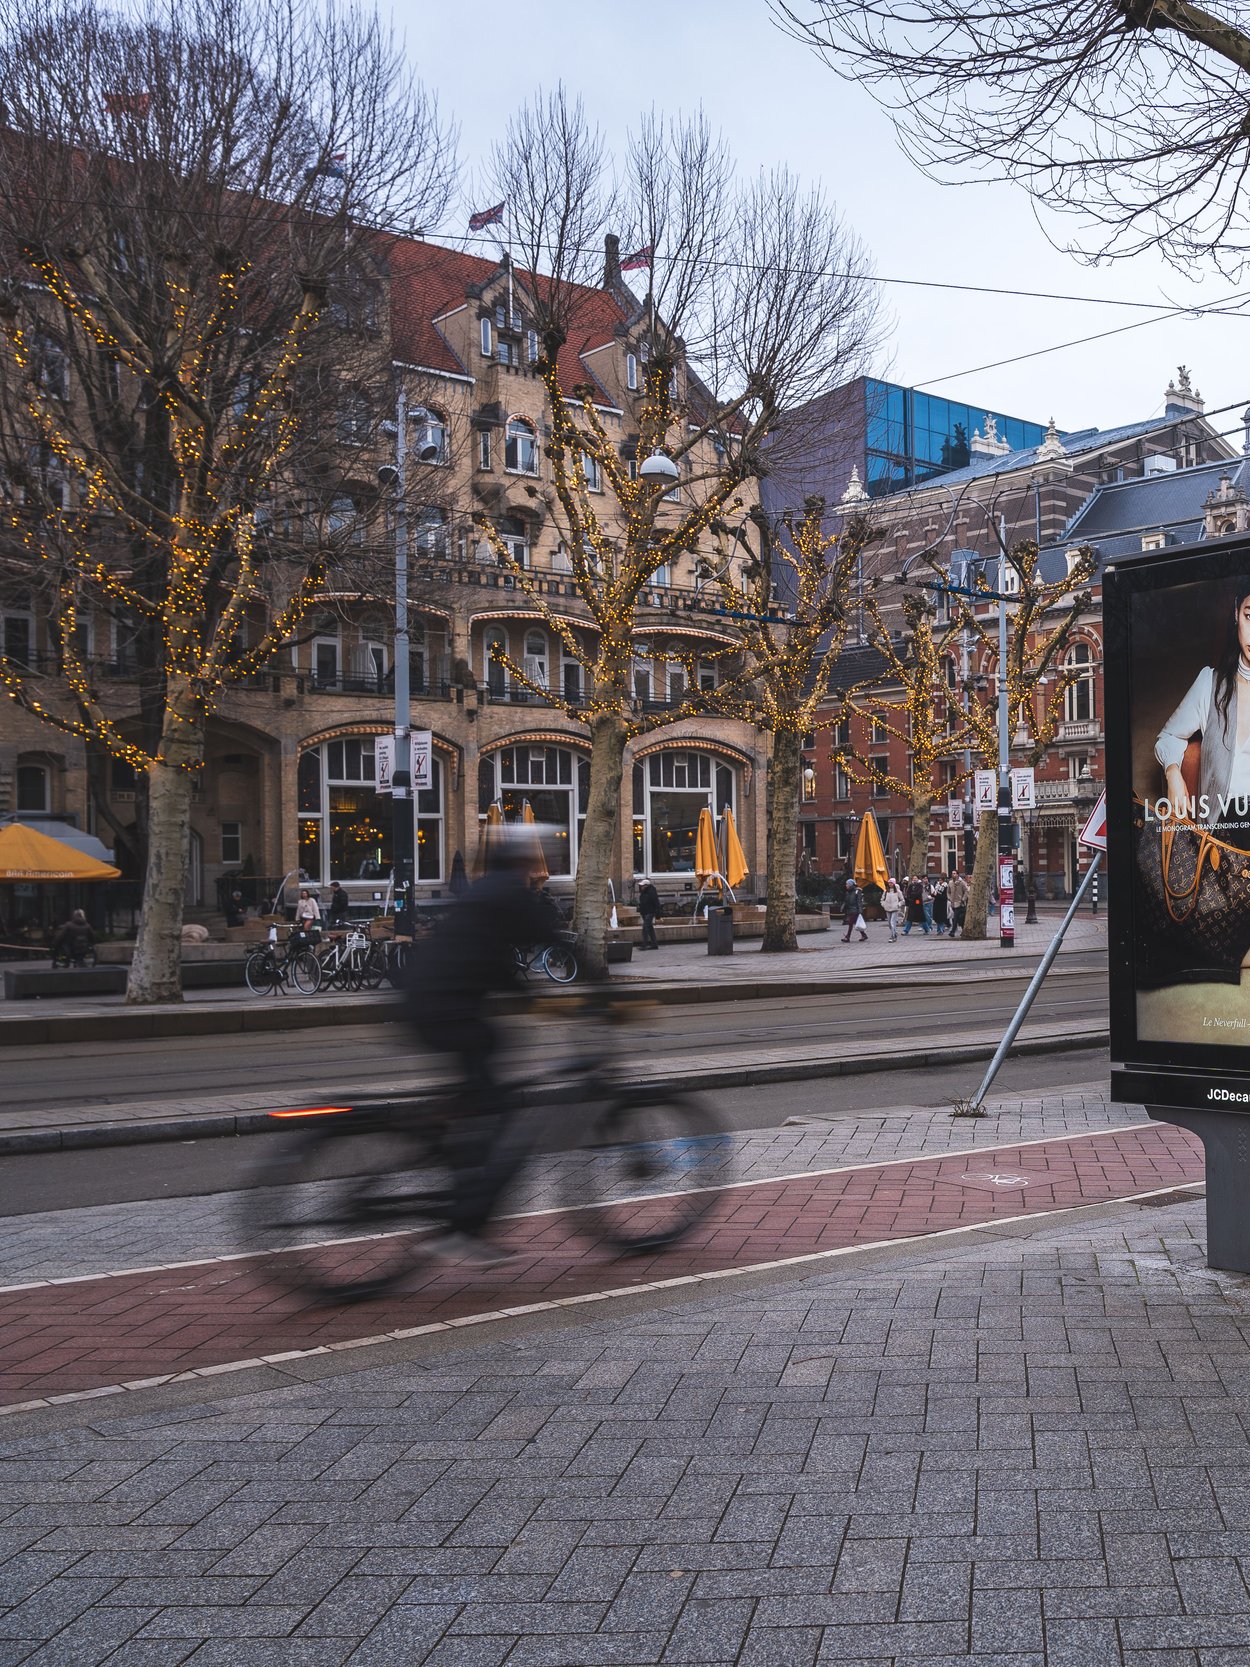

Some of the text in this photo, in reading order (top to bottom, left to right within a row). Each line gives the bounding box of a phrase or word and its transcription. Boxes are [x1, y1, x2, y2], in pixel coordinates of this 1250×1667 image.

[1144, 794, 1210, 821] LOUIS
[1198, 822, 1239, 830] TRANSCENDING
[1203, 1017, 1212, 1026] Le
[1213, 1018, 1246, 1029] Neverfull
